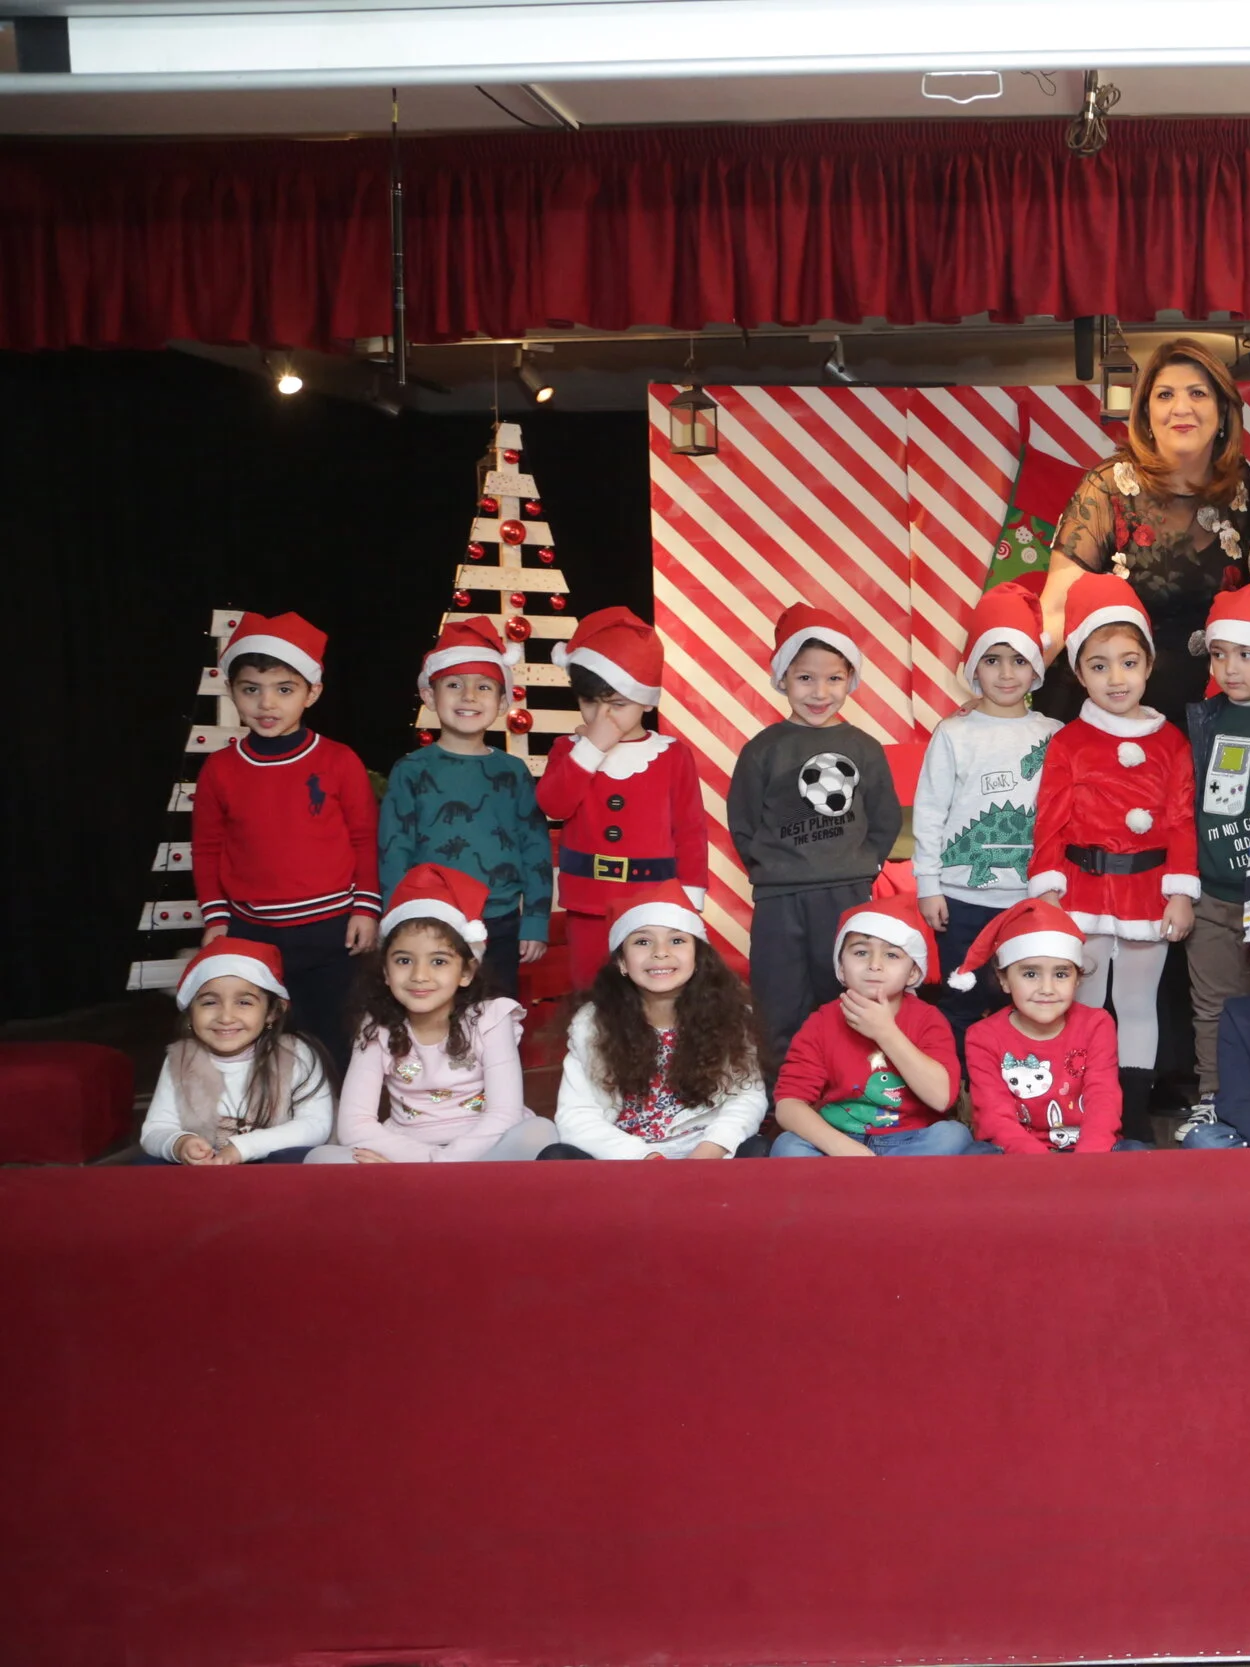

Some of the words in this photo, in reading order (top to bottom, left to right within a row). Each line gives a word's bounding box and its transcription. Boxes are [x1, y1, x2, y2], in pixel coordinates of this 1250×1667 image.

[780, 821, 806, 839] BEST
[809, 814, 846, 831] PLAYER
[793, 833, 809, 846] THE
[812, 826, 844, 842] SEASON
[1208, 827, 1219, 841] I'M
[1222, 821, 1239, 836] NOT
